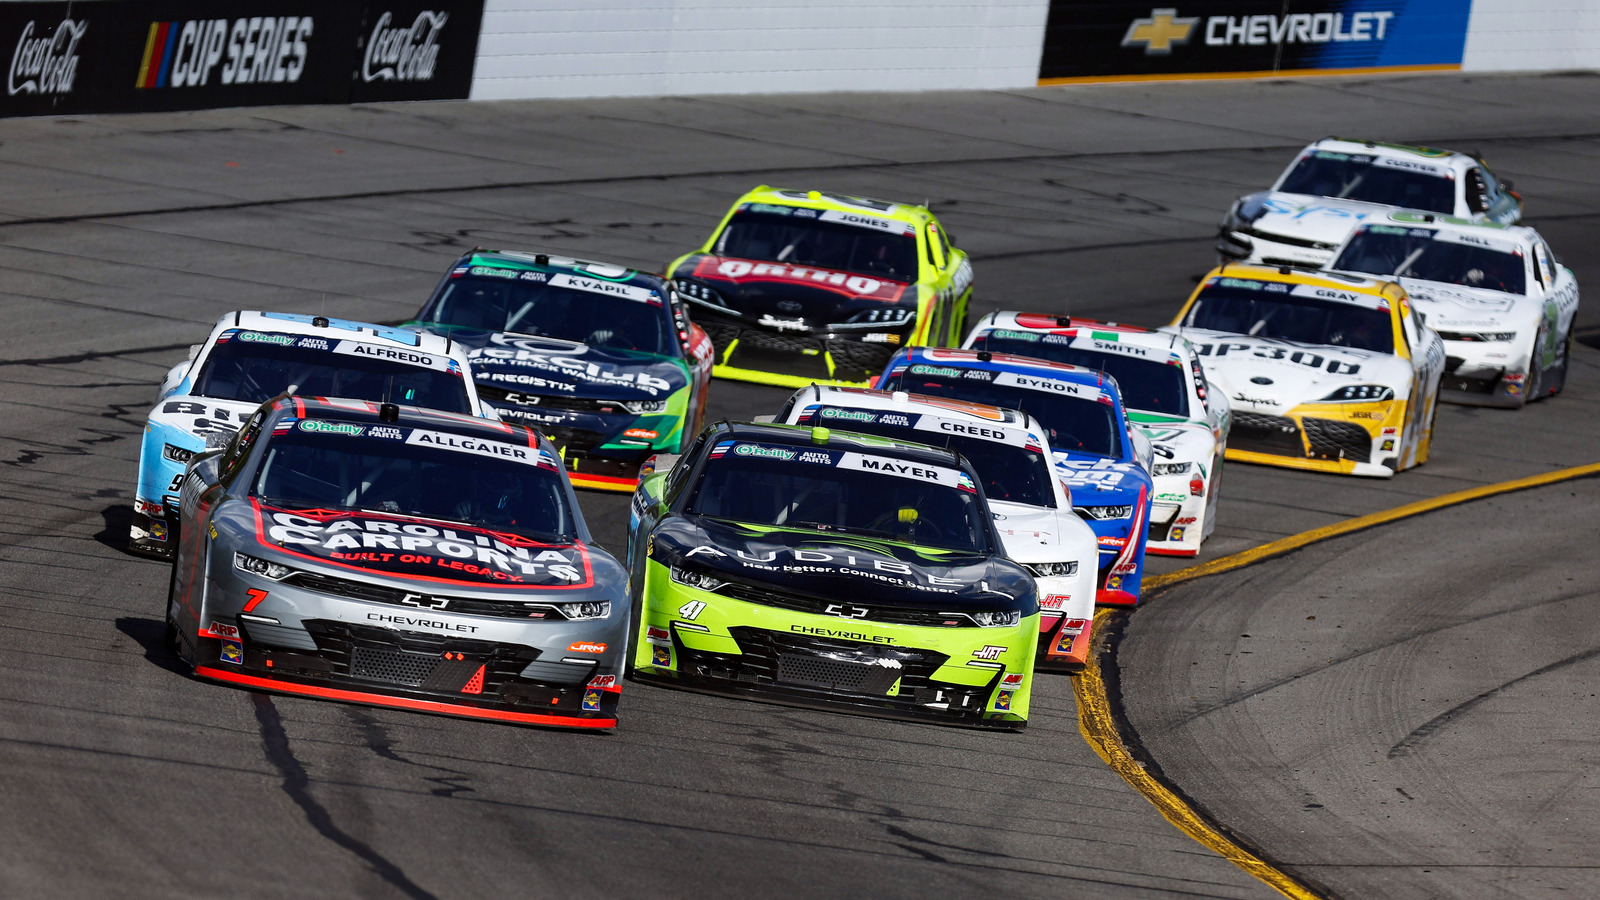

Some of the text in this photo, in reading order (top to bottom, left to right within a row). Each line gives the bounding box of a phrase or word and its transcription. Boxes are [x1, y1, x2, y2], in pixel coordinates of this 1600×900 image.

[1206, 11, 1393, 45] CHEVROLET
[171, 17, 314, 87] CUP SERIES
[1386, 158, 1438, 172] CUSTER
[840, 214, 889, 228] JONES
[1459, 235, 1490, 245] HILL
[471, 266, 519, 279] O'Reilly
[520, 274, 547, 282] PARTS
[718, 261, 881, 294] ORTHO
[568, 278, 630, 295] KVAPIL
[1316, 289, 1359, 301] GRAY
[238, 331, 297, 346] O'Reilly
[302, 337, 328, 345] AUTO
[993, 330, 1039, 341] O'Reilly
[1042, 337, 1068, 345] PARTS
[298, 341, 328, 350] PARTS
[1095, 341, 1146, 356] SMITH
[354, 345, 432, 365] ALFREDO
[509, 359, 560, 373] TRUCK
[562, 368, 659, 396] WARRANTIES
[912, 365, 963, 378] O'Reilly
[964, 373, 992, 381] PARTS
[492, 372, 577, 392] REGISTIX
[1017, 377, 1079, 394] BYRON
[1232, 392, 1281, 408] Supra
[822, 408, 877, 422] O'Reilly
[879, 418, 909, 426] PARTS
[298, 420, 366, 436] O'Reilly
[368, 430, 403, 440] PARTS
[371, 426, 400, 434] AUTO
[940, 422, 1006, 440] CREED
[419, 433, 527, 460] ALLGAIER
[734, 445, 797, 461] O'Reilly
[799, 456, 832, 465] PARTS
[802, 451, 830, 459] AUTO
[862, 459, 939, 480] MAYER
[141, 502, 163, 514] ARP
[1175, 517, 1197, 525] ARP
[272, 512, 572, 563] CAROLINA
[1098, 538, 1125, 546] JRM
[269, 526, 582, 581] CARPORTS
[330, 551, 395, 563] BUILT
[400, 554, 431, 564] ON
[685, 545, 1014, 600] AUDIBEL
[1114, 563, 1136, 572] ARP
[743, 561, 959, 595] Hear better. Connect better.
[242, 588, 269, 613] 7
[679, 600, 707, 621] 41
[210, 621, 238, 635] ARP
[367, 612, 479, 633] CHEVROLET
[790, 624, 894, 643] CHEVROLET
[571, 643, 605, 653] JRM
[590, 675, 615, 686] ARP
